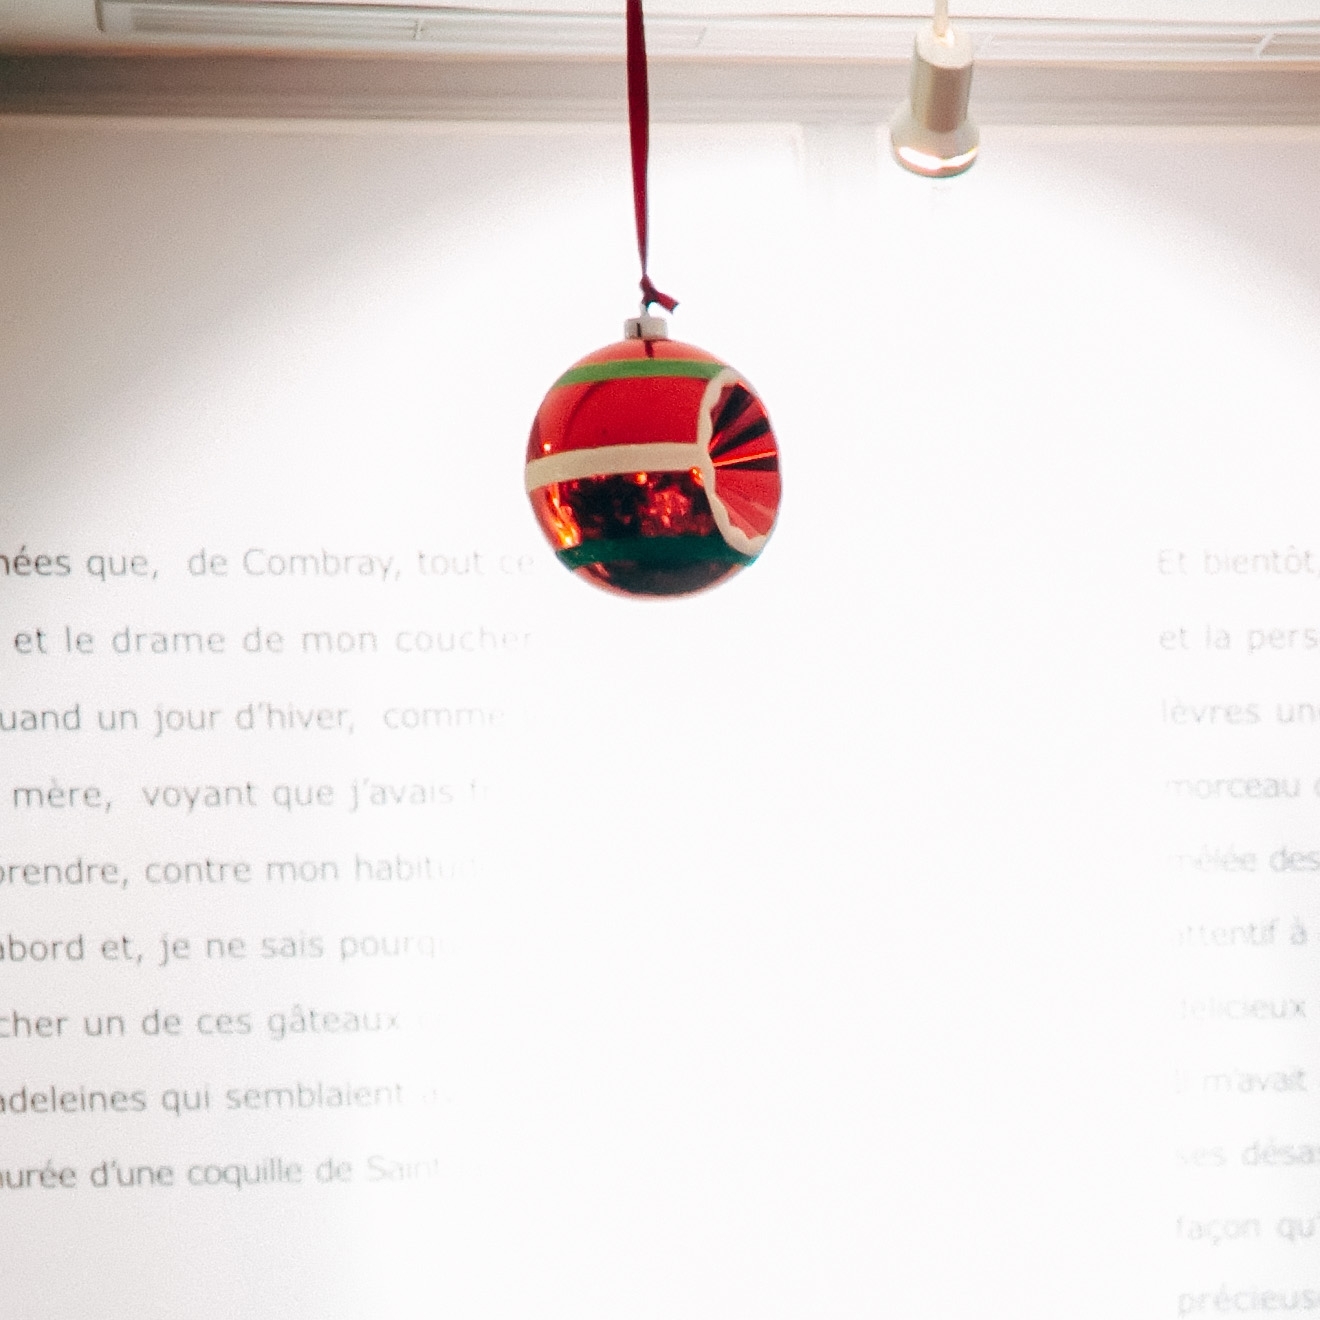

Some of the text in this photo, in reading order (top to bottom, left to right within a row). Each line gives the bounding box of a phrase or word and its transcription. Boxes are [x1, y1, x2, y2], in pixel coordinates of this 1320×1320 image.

[86, 550, 160, 581] que,
[187, 548, 229, 578] de
[242, 547, 402, 583] Combray,
[416, 548, 486, 577] tout
[1157, 548, 1189, 576] Et
[12, 623, 532, 655] et le drame de mon coucher
[1158, 626, 1190, 651] et
[1205, 623, 1231, 651] la
[97, 705, 139, 731] un
[153, 701, 222, 738] jour
[235, 699, 356, 735] d'hiver,
[382, 703, 506, 730] comme
[1161, 696, 1261, 725] lèvres
[12, 778, 113, 813] mère,
[141, 781, 257, 813] voyant
[271, 783, 335, 813] que
[348, 776, 455, 813] j'avais
[145, 856, 252, 884] contre
[266, 858, 339, 883] mon
[1290, 915, 1308, 946] à
[100, 934, 143, 964] et,
[159, 933, 190, 966] je
[206, 937, 247, 961] ne
[261, 933, 325, 960] sais
[84, 1013, 125, 1038] un
[141, 1008, 182, 1037] de
[197, 1011, 252, 1037] ces
[267, 1003, 399, 1042] gâteaux
[161, 1082, 211, 1118] qui
[225, 1079, 405, 1112] semblaient
[1175, 1142, 1227, 1168] ses
[90, 1157, 174, 1188] d'une
[187, 1154, 302, 1192] coquille
[315, 1155, 354, 1184] de
[1176, 1215, 1260, 1246] façon
